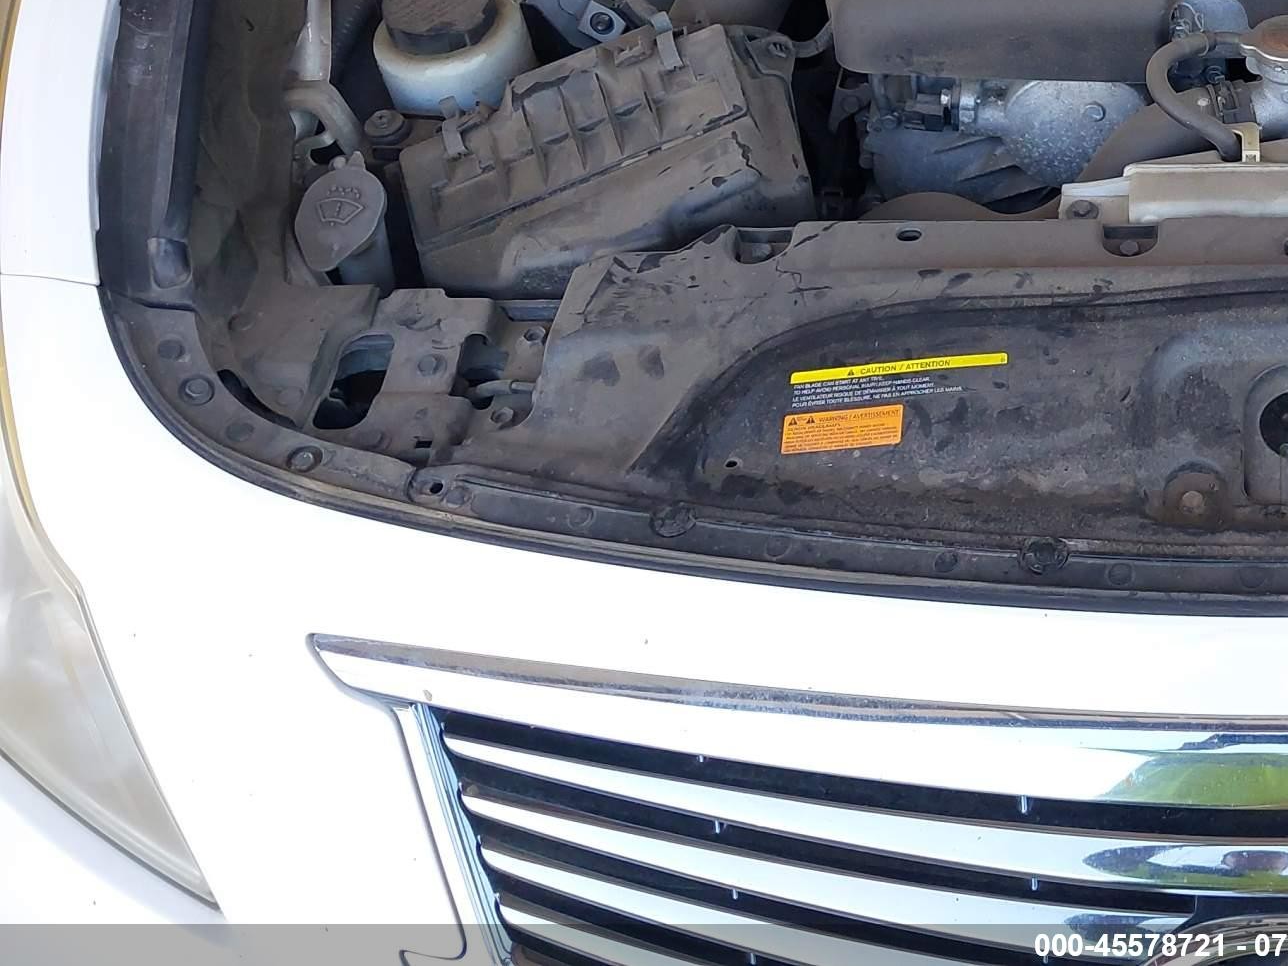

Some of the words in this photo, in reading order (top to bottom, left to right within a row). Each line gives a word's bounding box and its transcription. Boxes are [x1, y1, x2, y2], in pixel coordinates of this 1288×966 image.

[860, 365, 897, 374] CAUTION
[905, 360, 951, 370] ATTENTION
[801, 387, 815, 395] HELP
[815, 386, 832, 394] AVOID
[819, 414, 848, 422] WARNING
